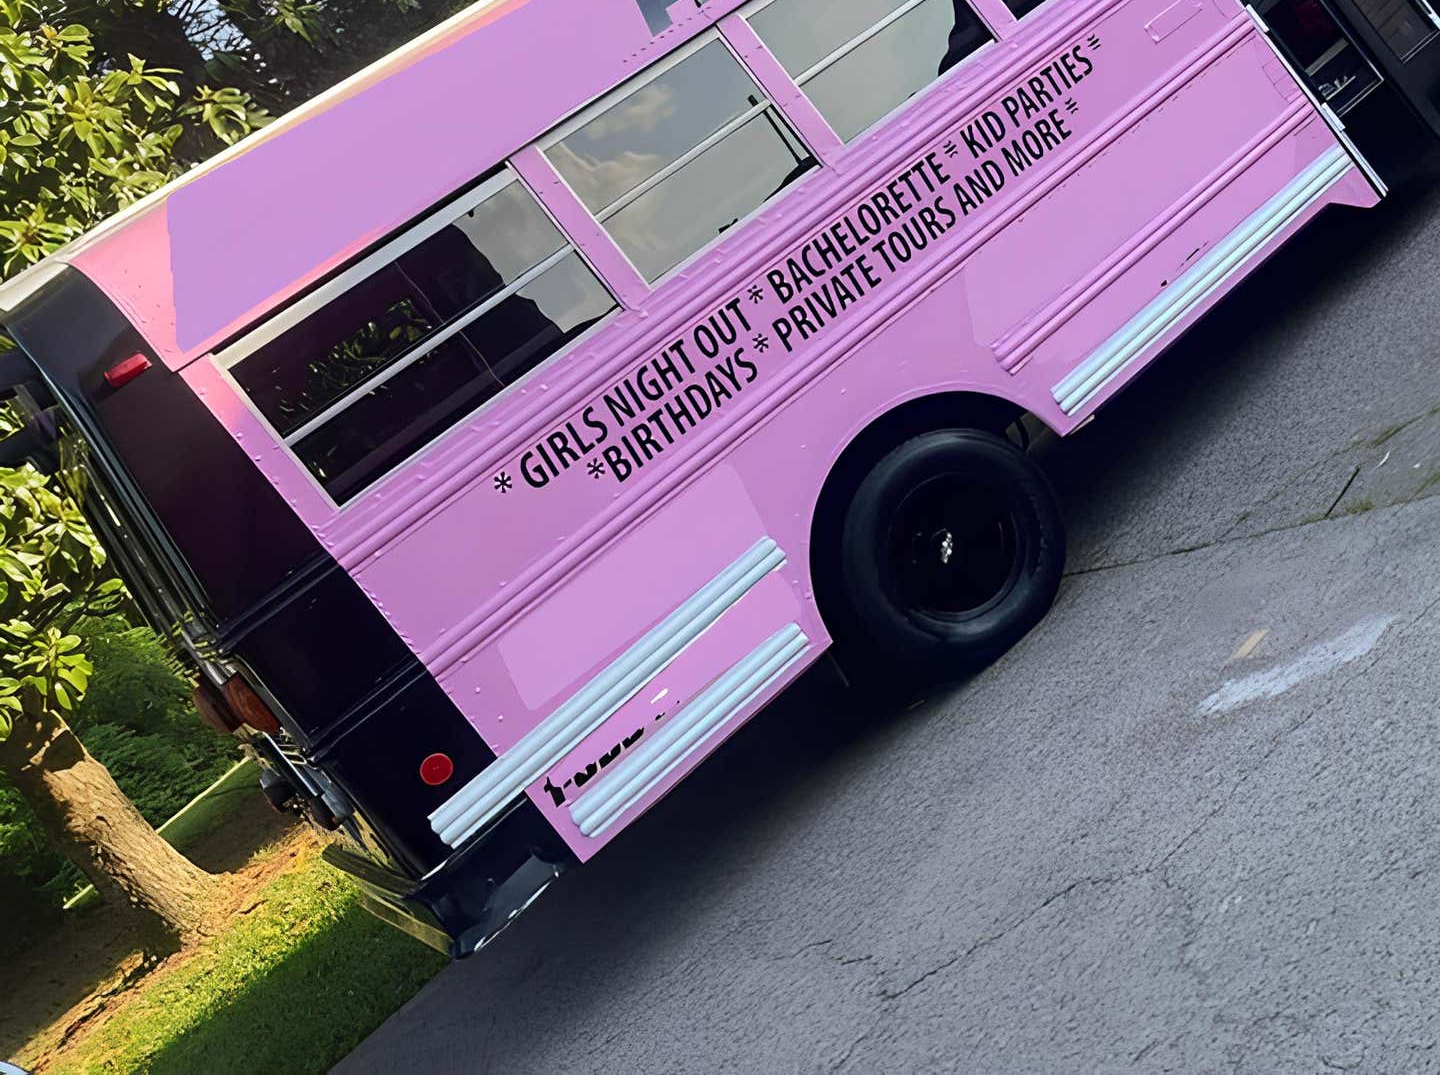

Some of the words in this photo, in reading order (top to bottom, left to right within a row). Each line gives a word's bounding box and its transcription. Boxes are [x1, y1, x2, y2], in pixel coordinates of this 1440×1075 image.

[520, 406, 608, 488] GIRLS
[603, 339, 696, 426] NIGHT
[693, 297, 751, 359] OUT
[766, 152, 951, 304] BACHELORETTE
[960, 111, 1006, 158] KID
[1001, 45, 1093, 127] PARTIES
[602, 348, 758, 482] BIRTHDAYS
[772, 254, 882, 352] PRIVATE
[872, 195, 956, 272] TOURS
[953, 160, 1005, 216] AND
[1000, 108, 1072, 177] MORE
